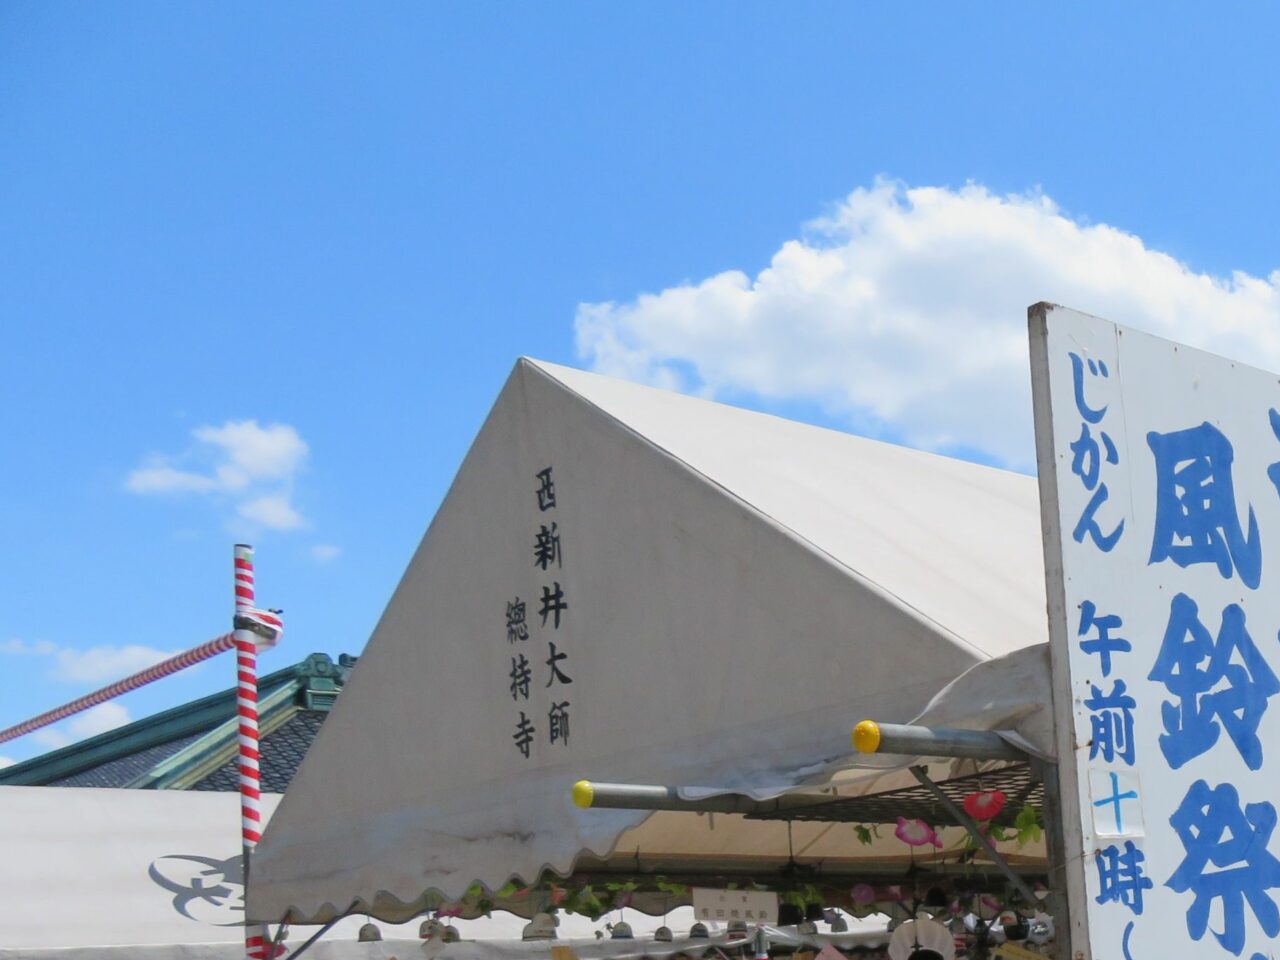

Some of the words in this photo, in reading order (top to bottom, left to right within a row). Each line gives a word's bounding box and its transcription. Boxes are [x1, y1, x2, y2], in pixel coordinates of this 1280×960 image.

[1068, 351, 1125, 552] じかん
[533, 466, 573, 747] 西新井大師
